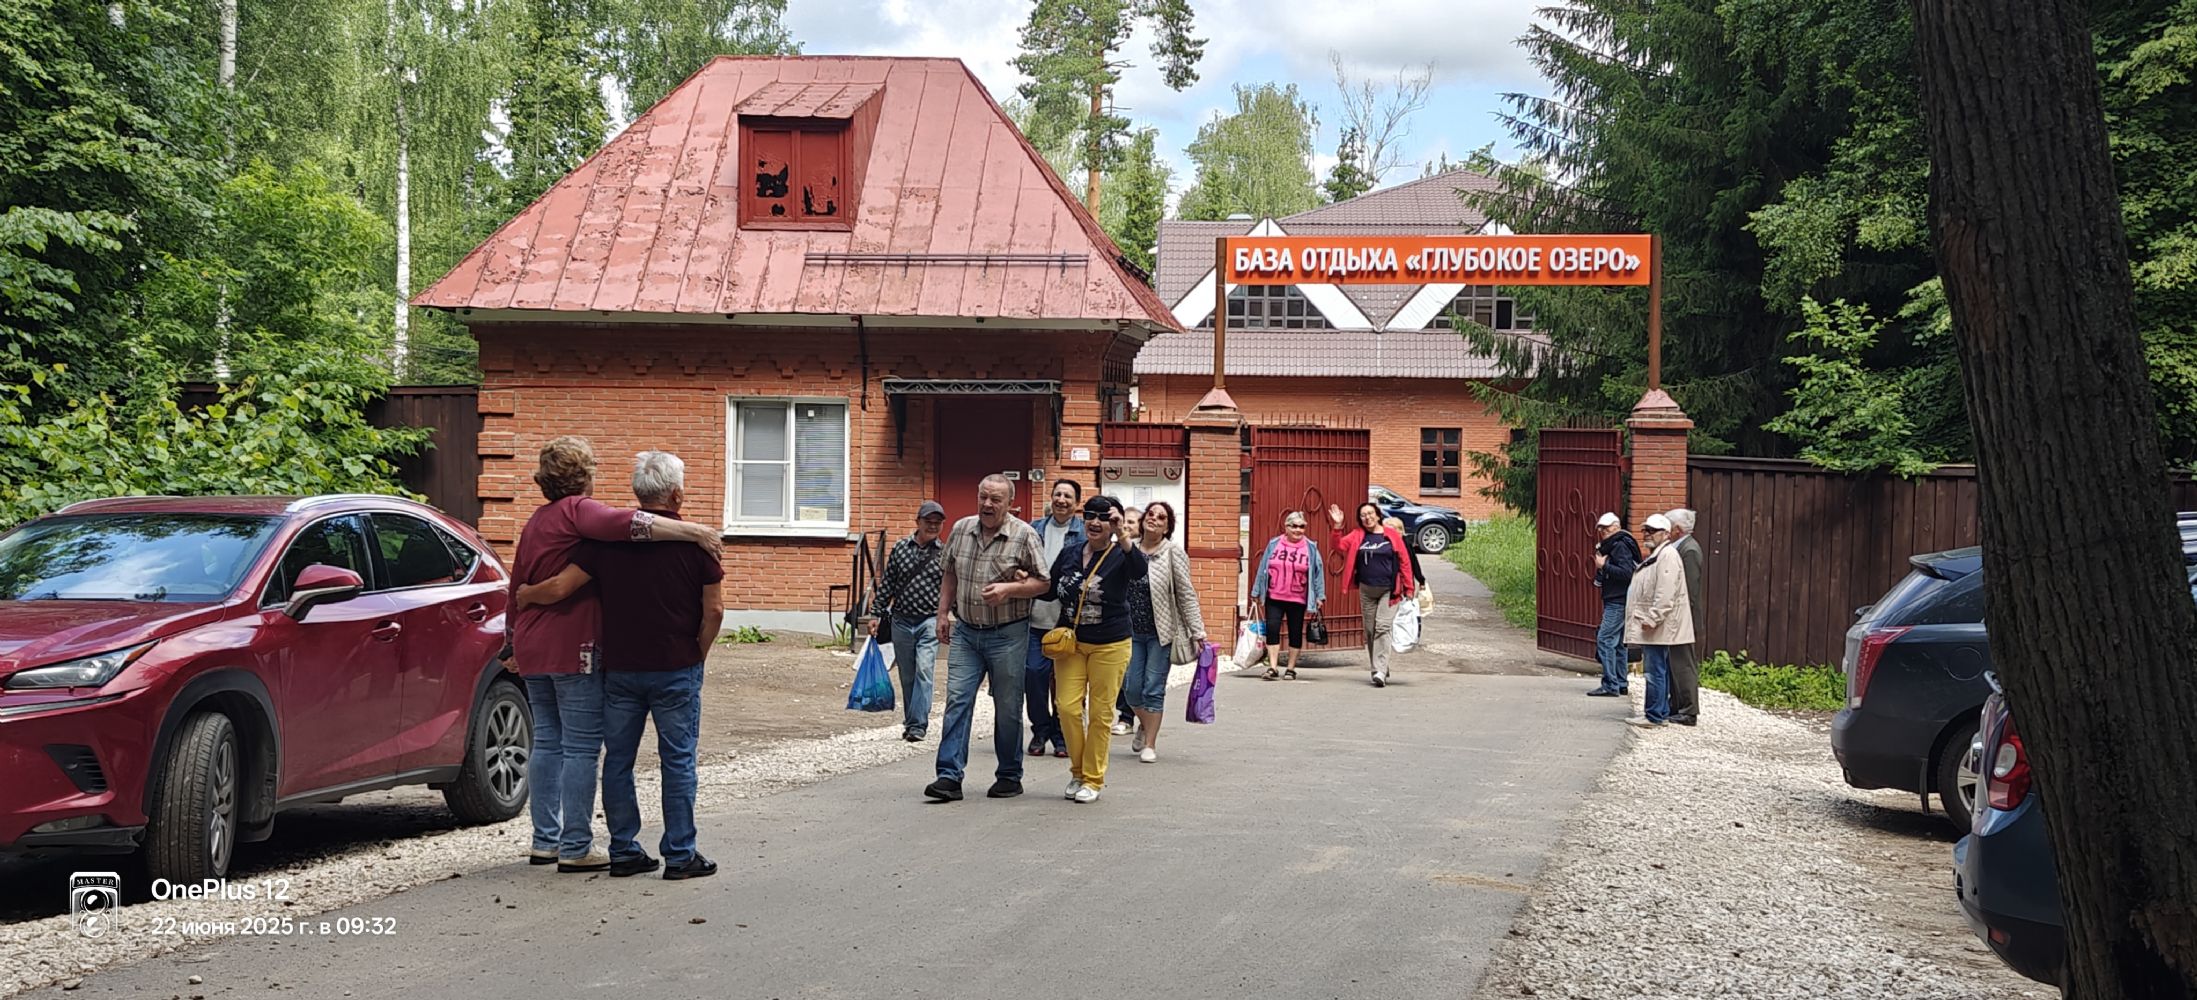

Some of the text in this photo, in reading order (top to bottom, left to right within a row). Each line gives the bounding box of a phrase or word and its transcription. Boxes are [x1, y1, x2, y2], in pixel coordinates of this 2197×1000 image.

[1235, 247, 1641, 276] БАЗА ОТДЫХА «ГЛУБОКОЕ ОЗЕРО»
